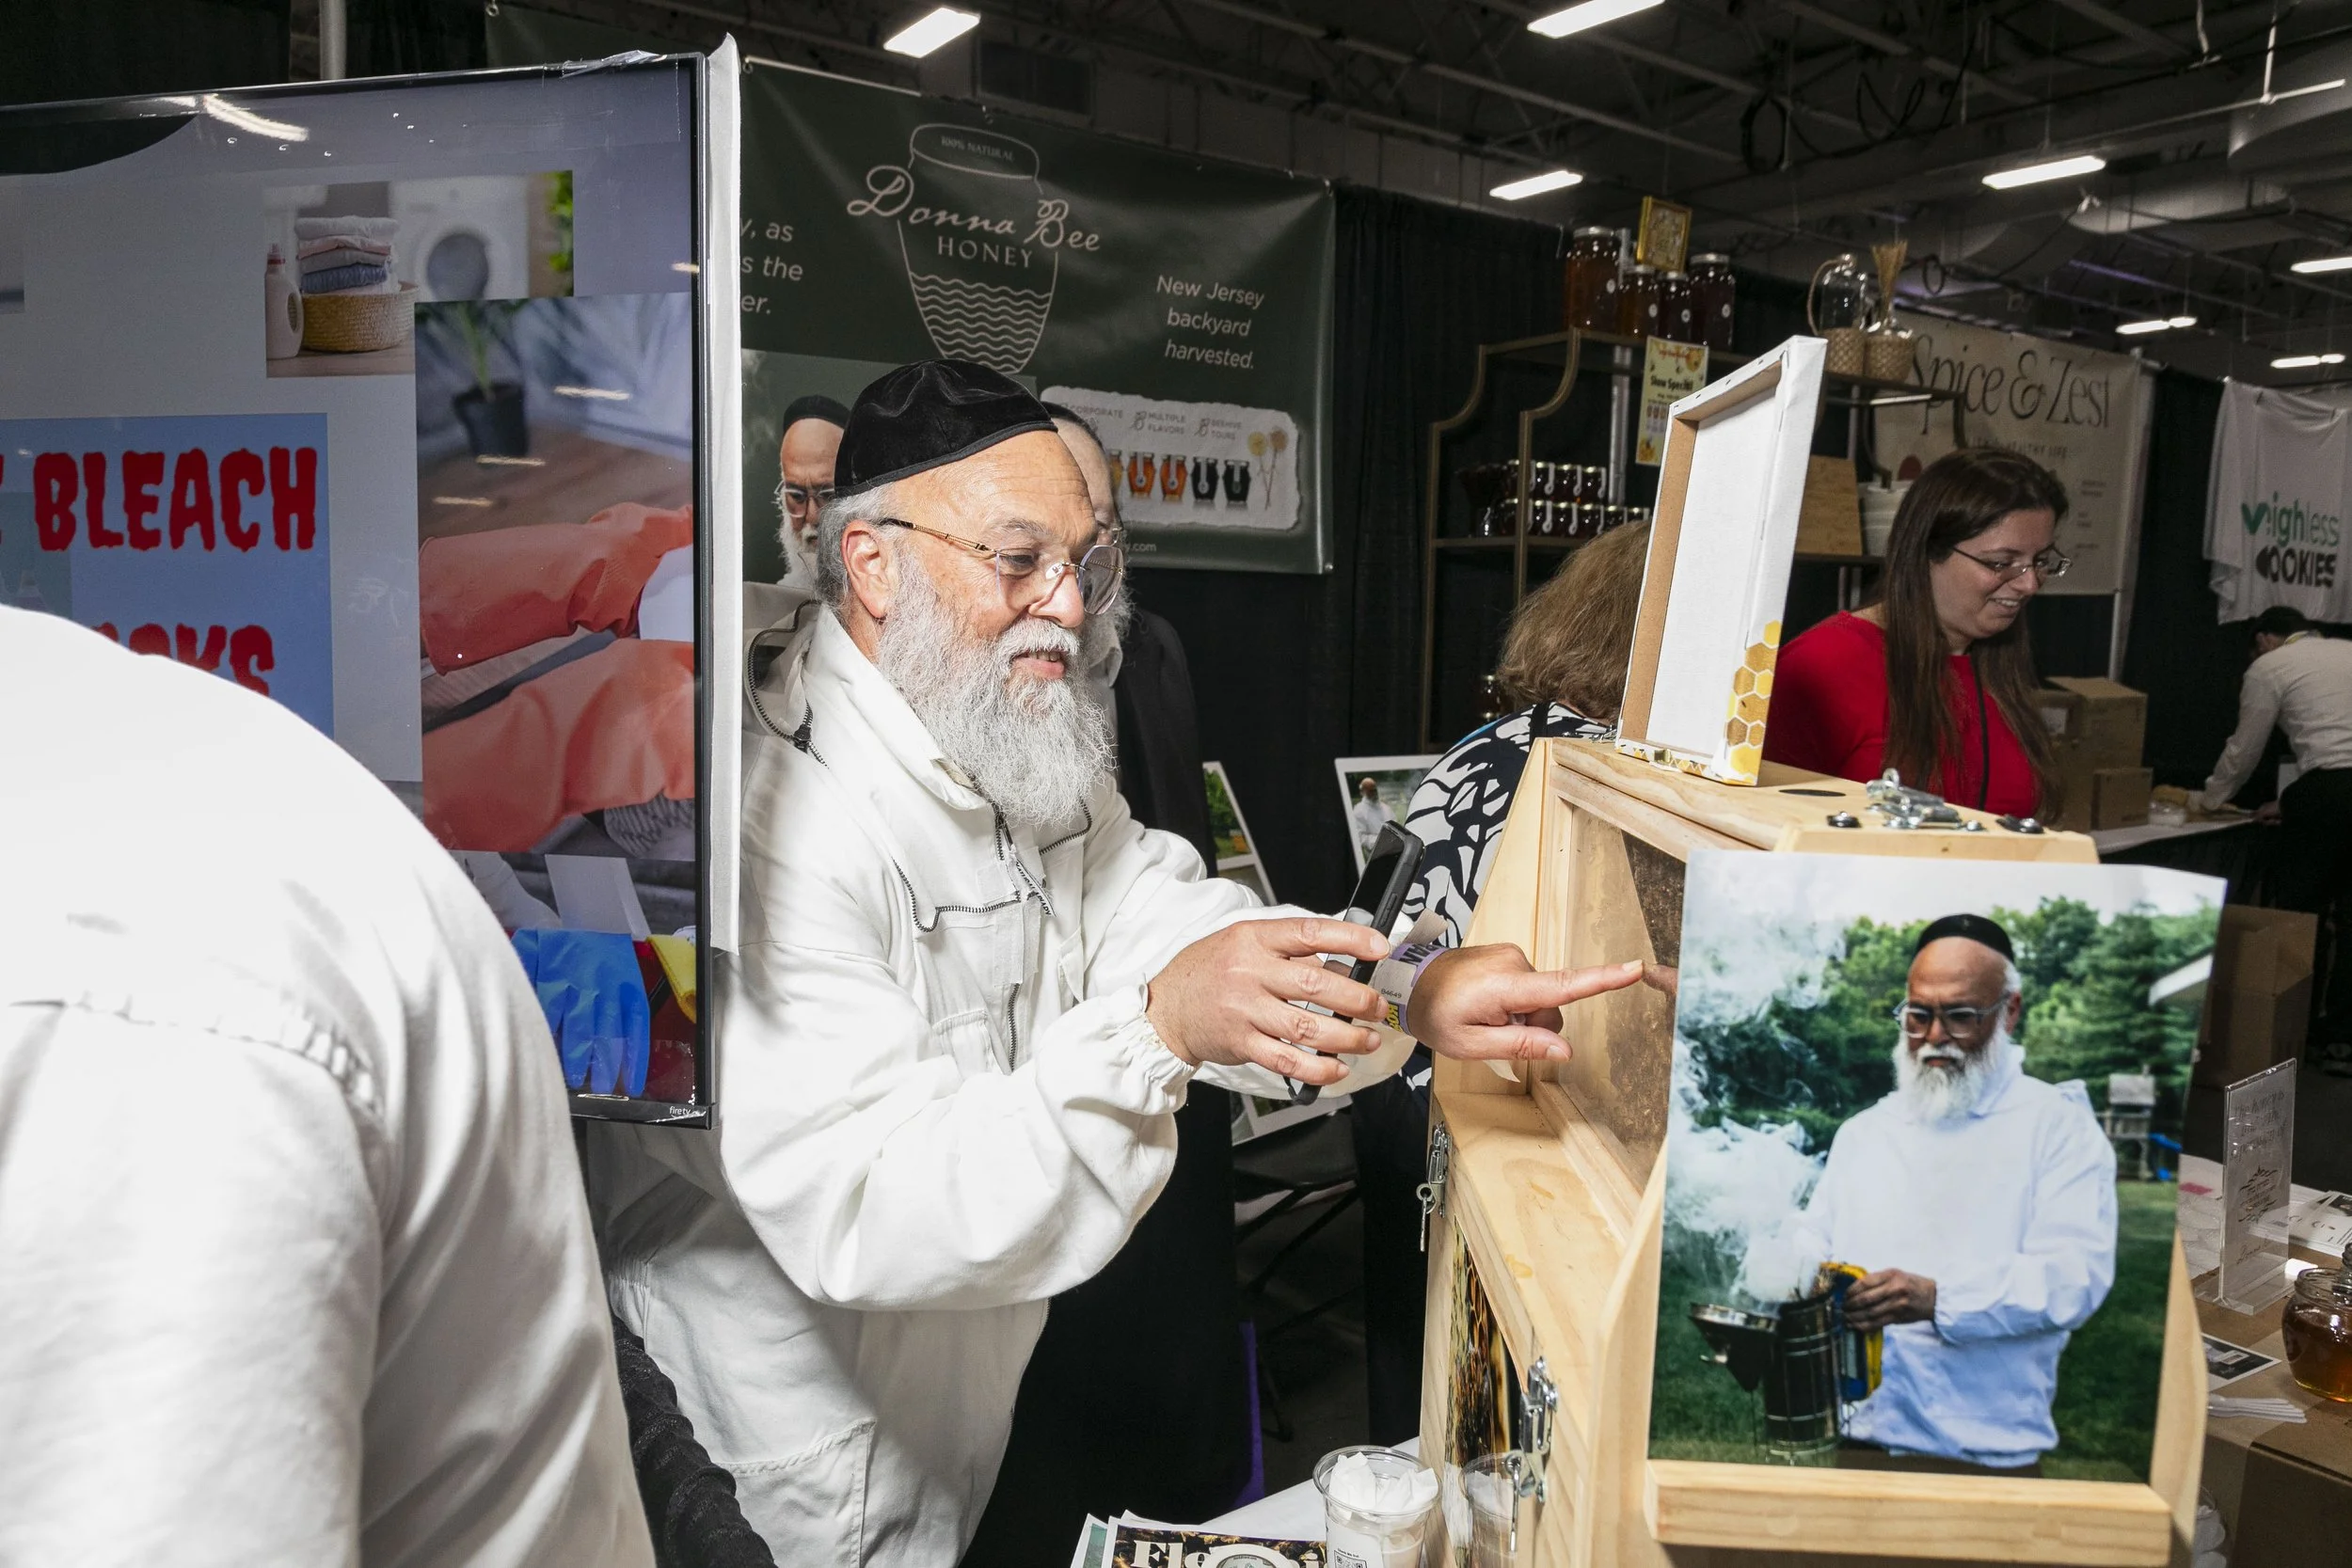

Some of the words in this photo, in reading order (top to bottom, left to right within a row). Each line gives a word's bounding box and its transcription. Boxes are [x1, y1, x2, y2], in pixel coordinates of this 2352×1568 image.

[967, 142, 1015, 163] NATURAL
[847, 165, 1016, 235] Donna
[1024, 198, 1101, 251] Bee
[766, 222, 794, 243] as
[937, 235, 1033, 268] HONEY
[763, 255, 803, 281] the
[1156, 274, 1201, 297] New
[1206, 282, 1265, 310] Jersey
[1168, 307, 1252, 337] backyard
[1165, 338, 1254, 370] harvested.
[1147, 412, 1186, 423] MULTIPLE
[1147, 423, 1185, 436] FLAVORS
[33, 446, 318, 553] BLEACH
